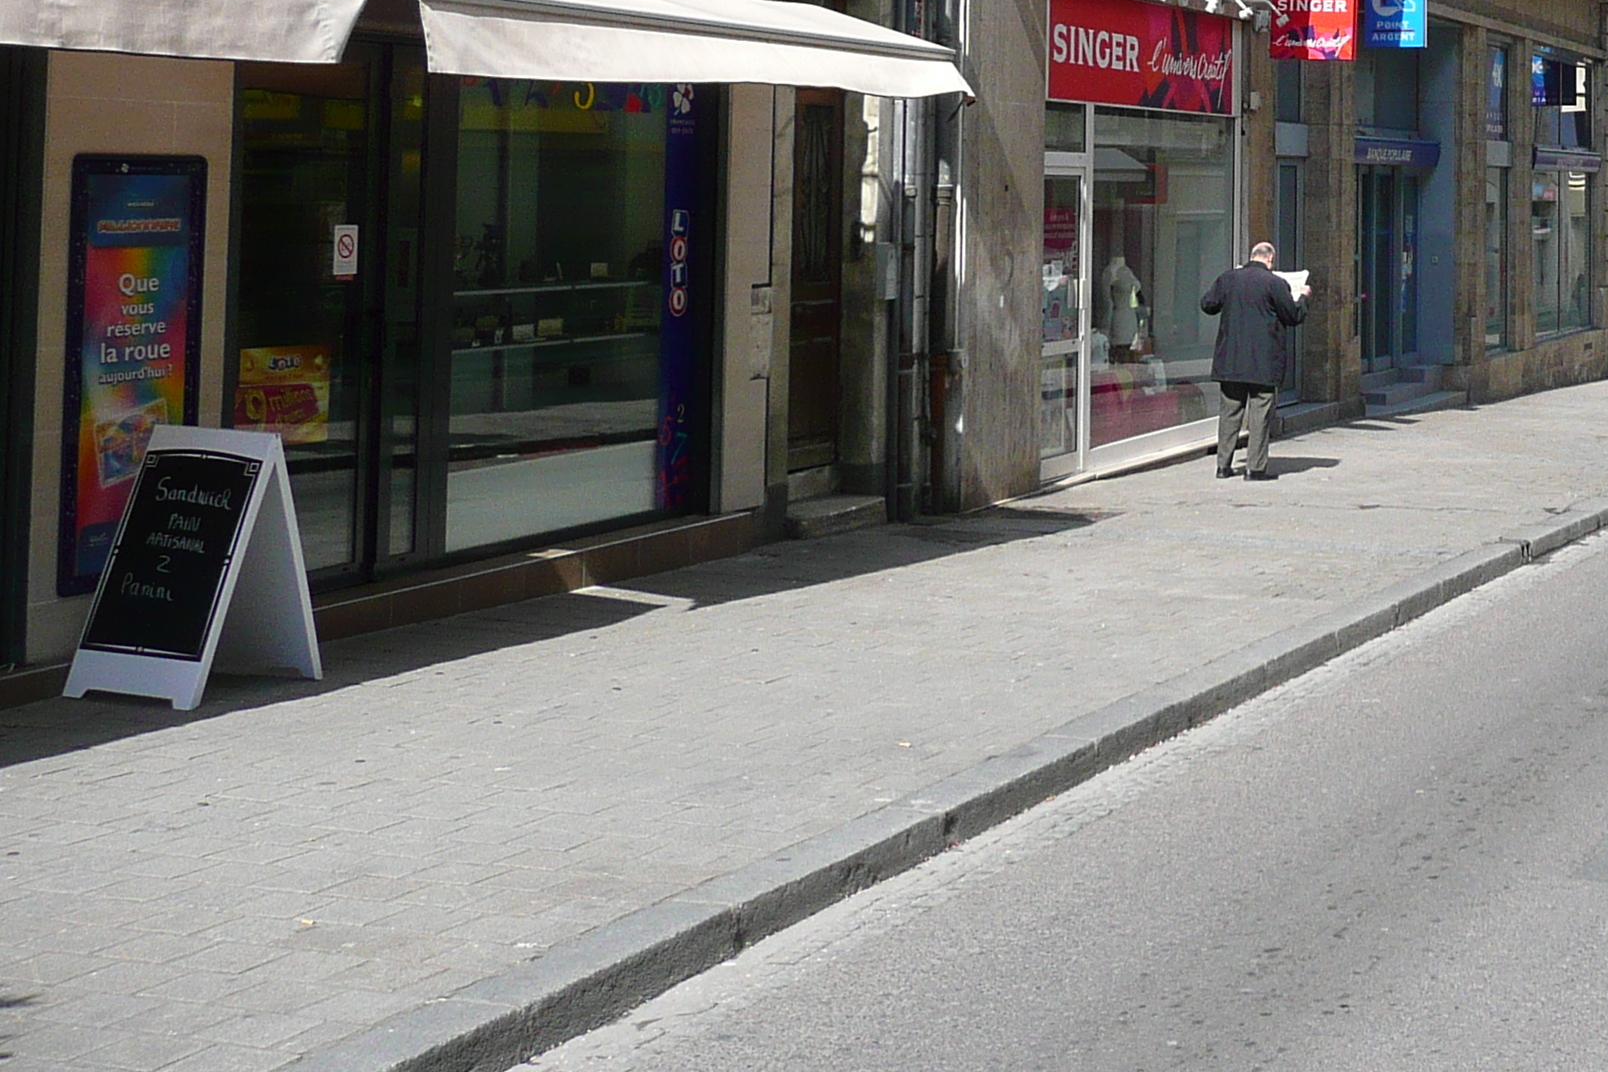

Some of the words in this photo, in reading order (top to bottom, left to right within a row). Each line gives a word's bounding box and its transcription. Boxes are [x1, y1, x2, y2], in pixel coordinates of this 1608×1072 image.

[1277, 0, 1347, 12] SINGER
[1376, 21, 1410, 29] POINT
[1372, 33, 1415, 41] ARGENT
[1053, 23, 1140, 73] SINGER
[670, 210, 690, 317] LOTO
[119, 273, 160, 296] Que
[121, 303, 155, 315] vous
[107, 320, 166, 337] réserve
[100, 342, 118, 364] la
[124, 343, 171, 361] roue
[99, 366, 165, 385] aujourd'hui
[155, 476, 232, 510] Sandwich
[167, 513, 201, 532] PAIN
